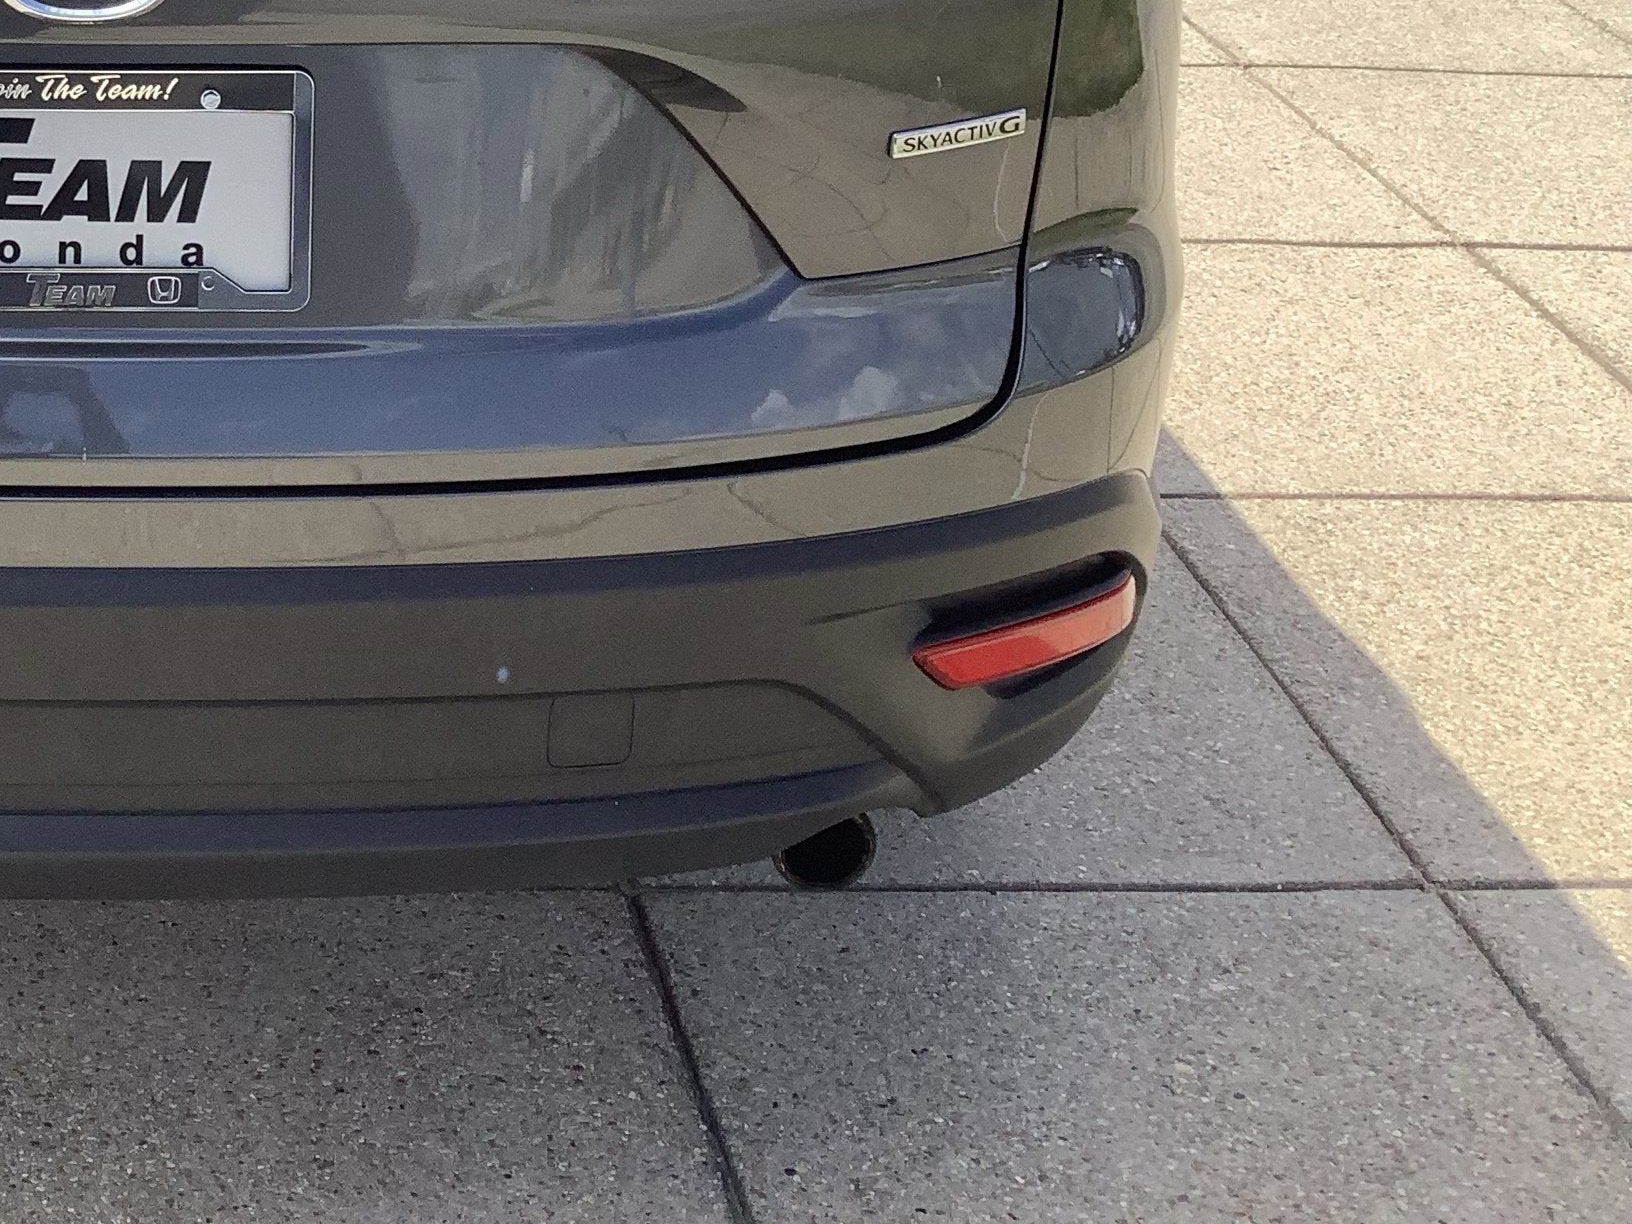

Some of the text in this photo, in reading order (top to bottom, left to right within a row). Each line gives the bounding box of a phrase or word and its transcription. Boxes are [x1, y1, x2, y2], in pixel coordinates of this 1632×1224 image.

[35, 74, 88, 102] The
[90, 74, 180, 102] Team!
[26, 273, 116, 307] TEAM
